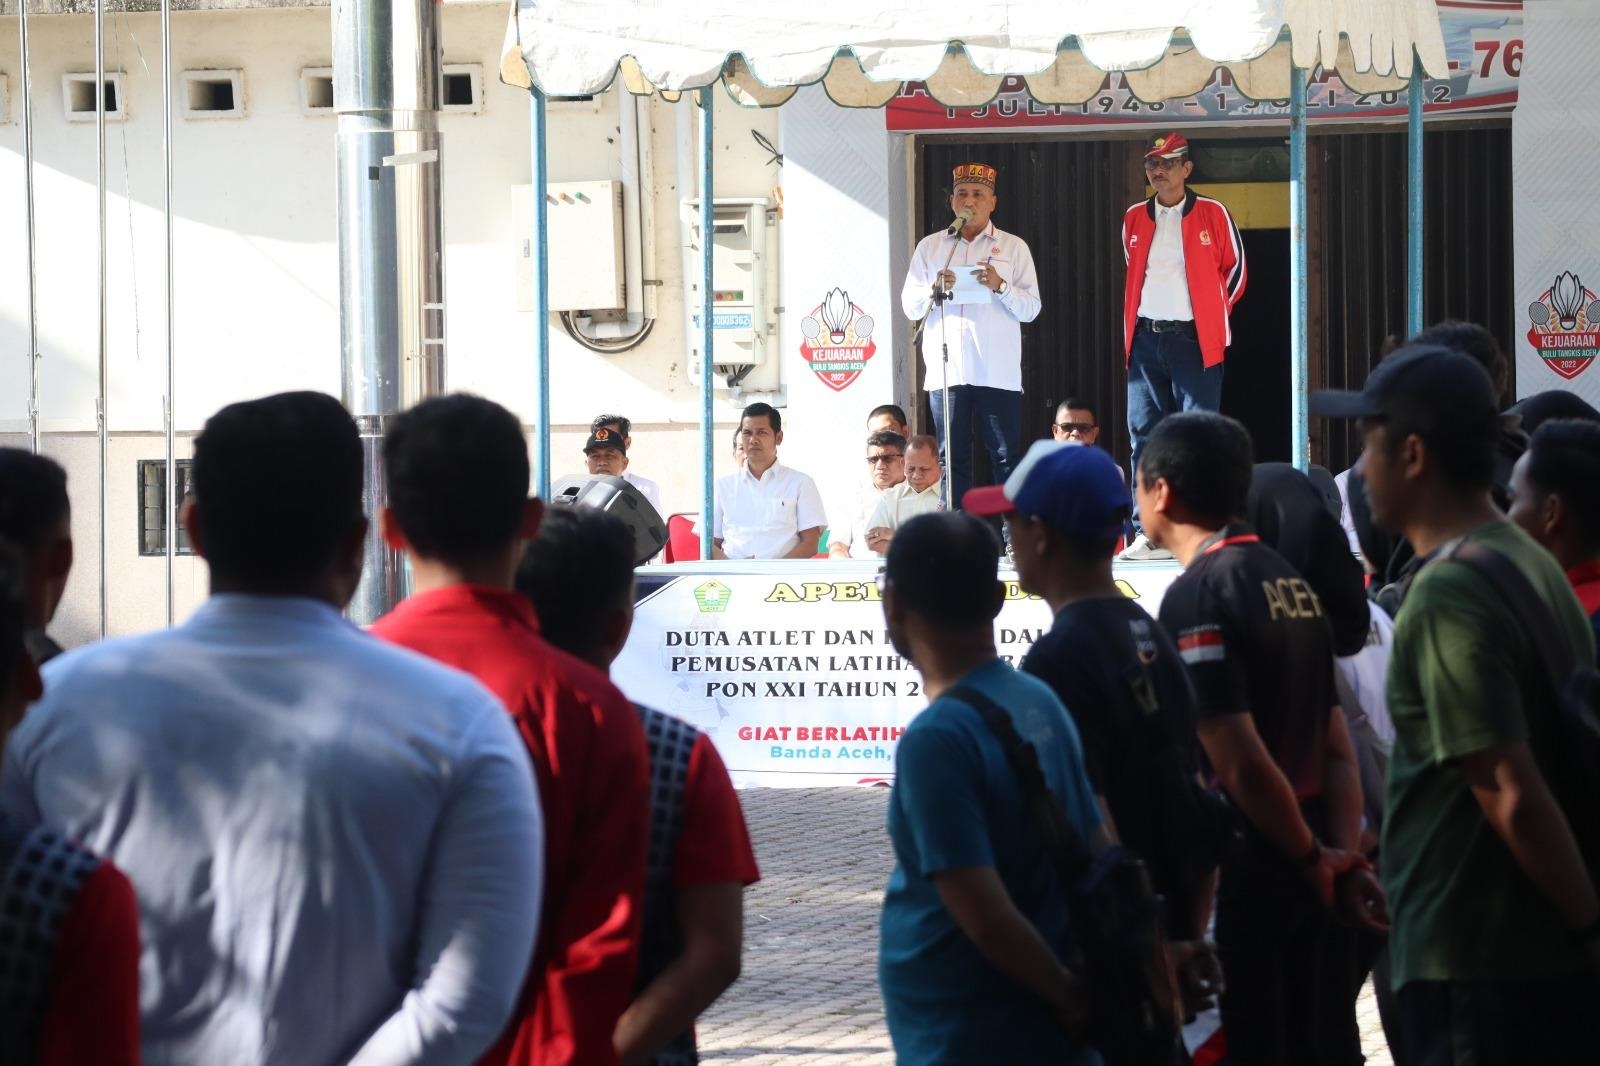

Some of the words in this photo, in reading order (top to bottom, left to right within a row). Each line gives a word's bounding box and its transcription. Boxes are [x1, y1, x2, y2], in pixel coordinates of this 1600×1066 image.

[1474, 38, 1523, 78] 76
[1354, 85, 1451, 106] 202
[1541, 334, 1596, 348] KEJUARAAN
[812, 348, 864, 361] KEJUARAAN
[1541, 349, 1557, 358] BULU
[1558, 349, 1581, 357] TANGKIS
[1581, 348, 1597, 357] ACEH
[1560, 360, 1577, 369] 2022
[830, 373, 845, 381] 2022
[666, 631, 730, 646] DUTA
[737, 630, 816, 646] ATLET
[824, 630, 874, 645] DAN
[671, 656, 820, 672] PEMUSATAN
[829, 655, 919, 671] LATIHA
[706, 682, 756, 698] PON
[764, 682, 806, 697] XXI
[814, 681, 897, 697] TAHUN
[738, 726, 792, 741] GIAT
[770, 746, 832, 759] Banda
[837, 746, 892, 761] Aceh,
